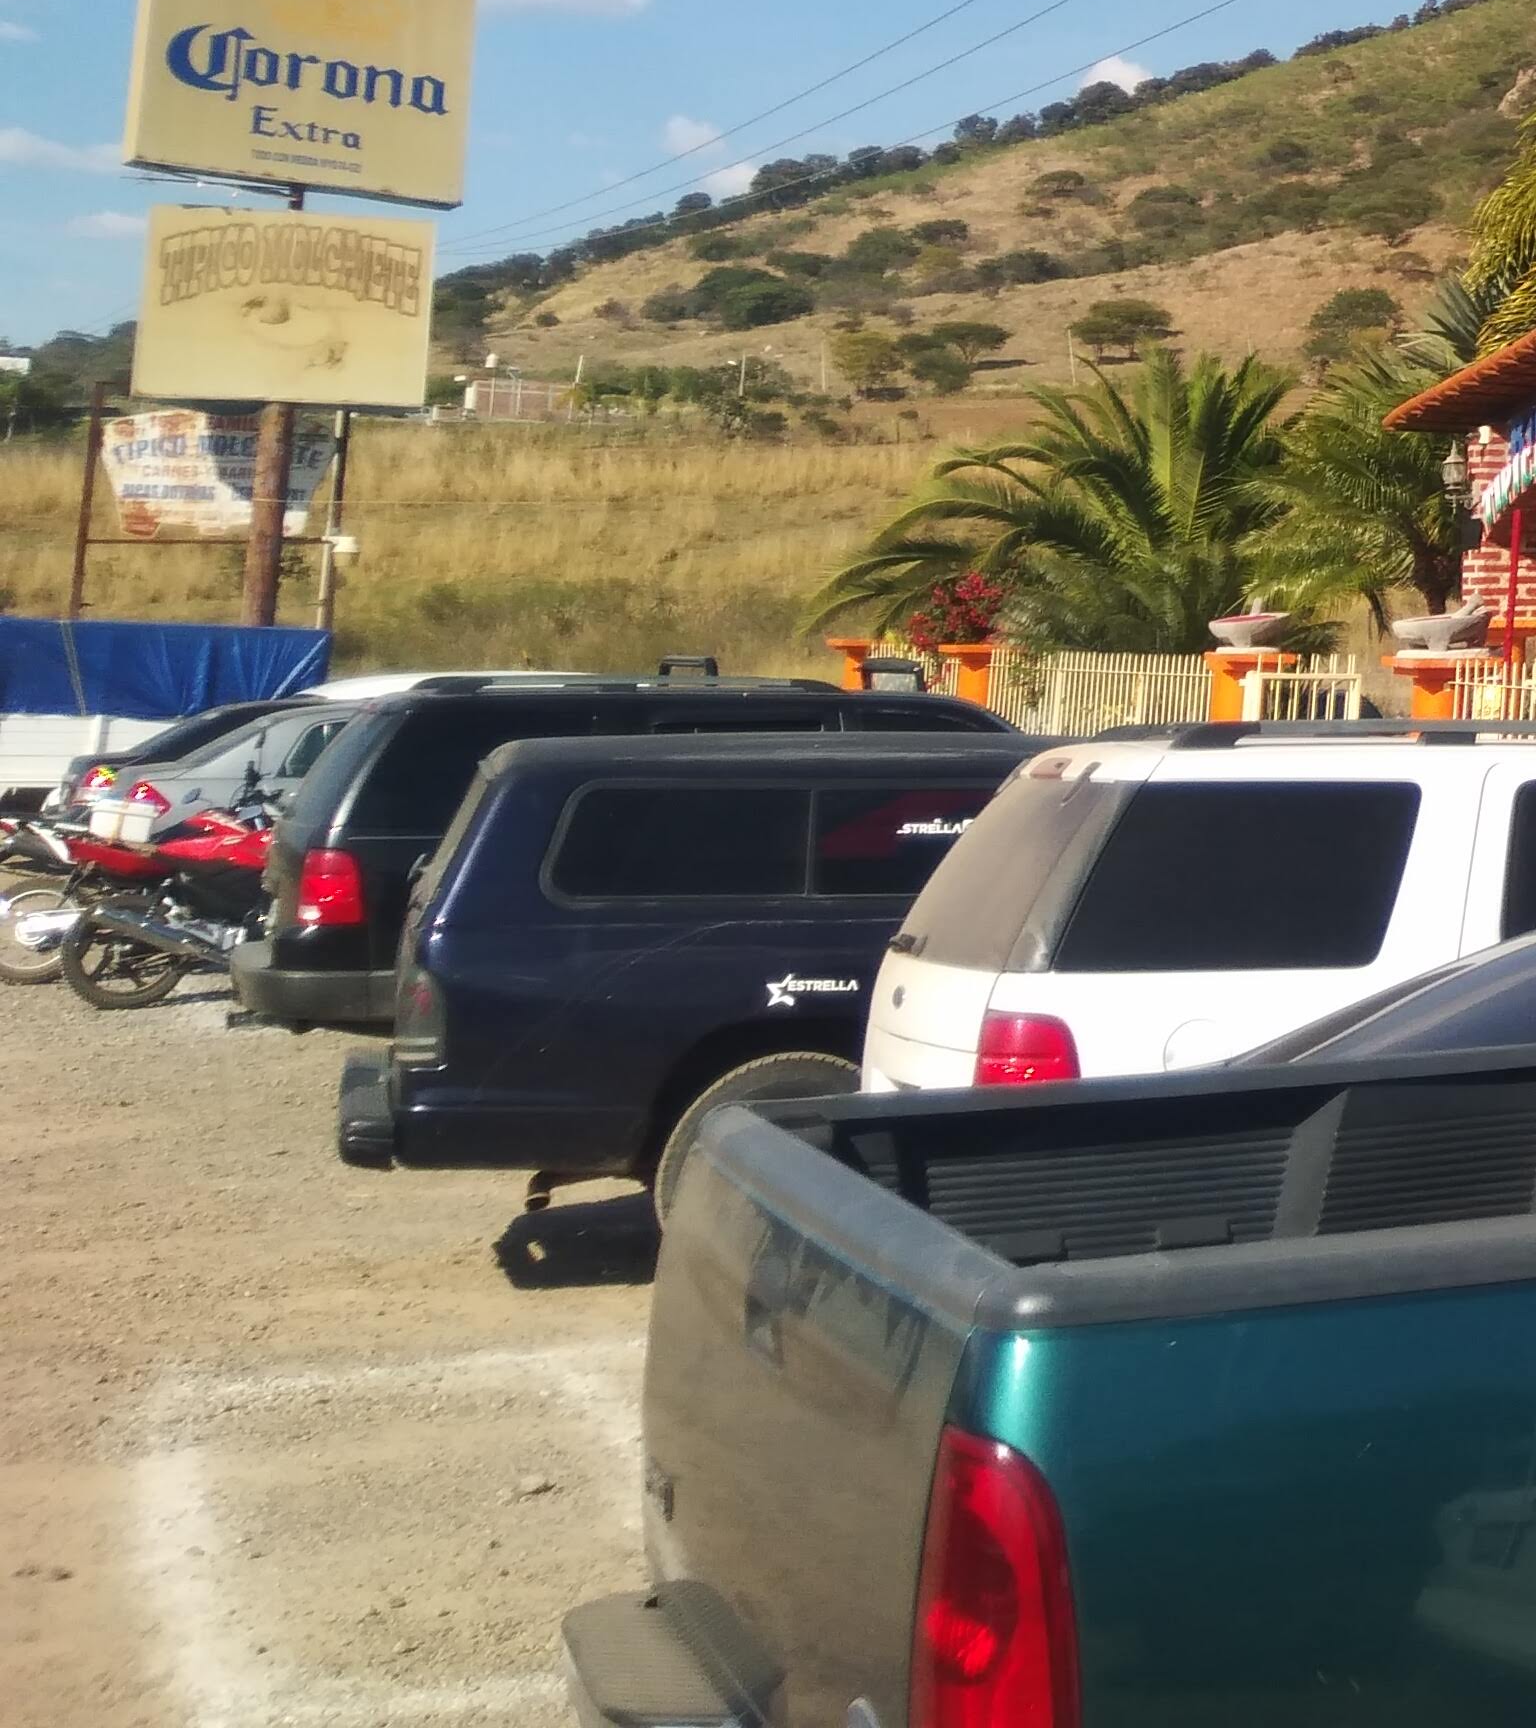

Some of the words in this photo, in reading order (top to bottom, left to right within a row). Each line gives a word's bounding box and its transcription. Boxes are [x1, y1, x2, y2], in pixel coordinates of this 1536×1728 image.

[165, 23, 450, 116] Corona
[250, 104, 363, 151] Extra
[896, 823, 962, 834] STRELLA
[787, 979, 859, 992] ESTRELLA
